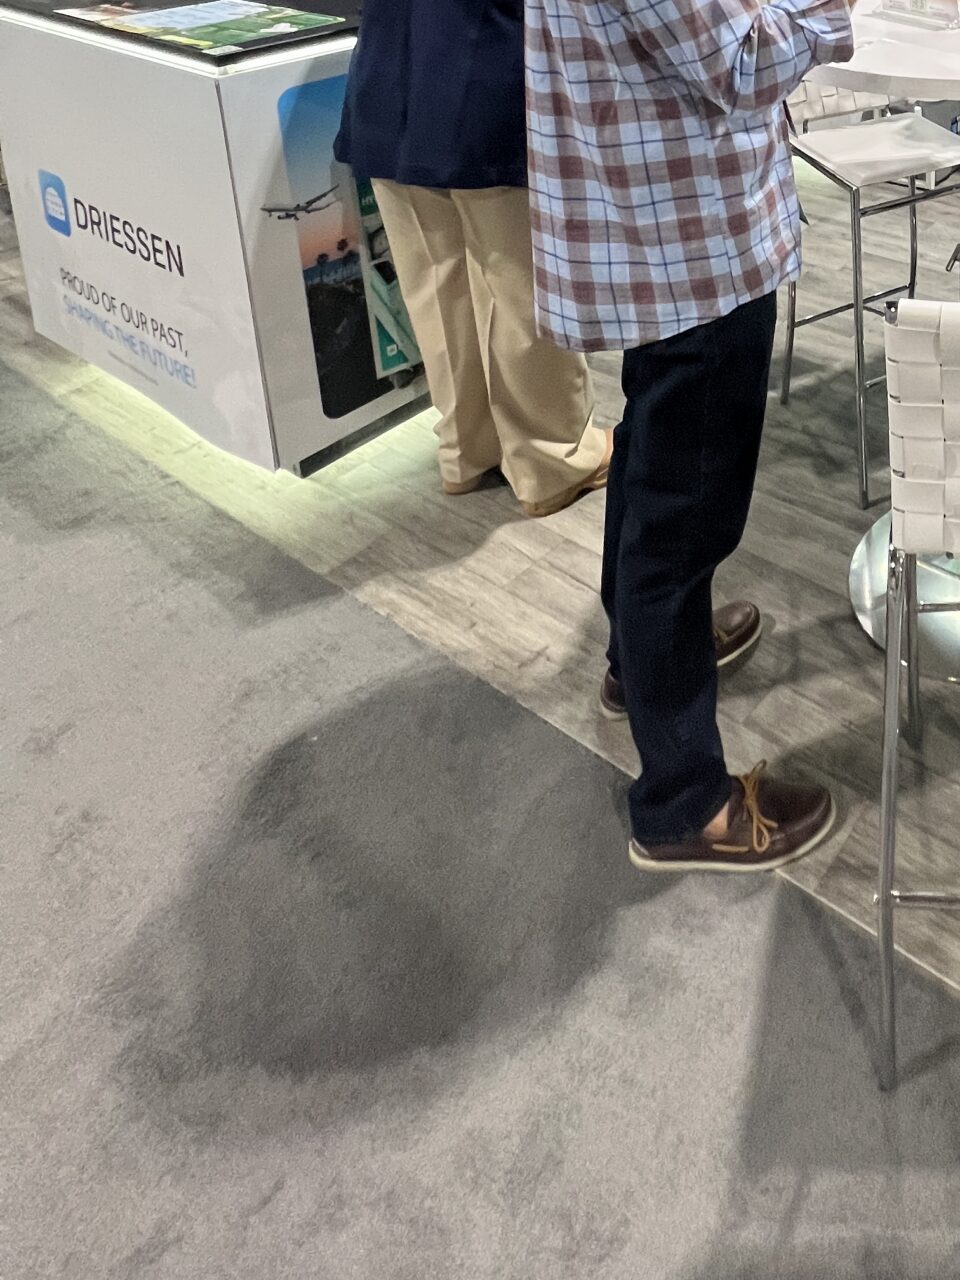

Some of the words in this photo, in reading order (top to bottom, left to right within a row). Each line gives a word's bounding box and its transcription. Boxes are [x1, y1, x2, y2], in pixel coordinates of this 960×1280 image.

[73, 197, 185, 278] DRIESSEN
[60, 267, 99, 305] PROUD
[101, 291, 118, 316] OF
[120, 302, 150, 335] OUR
